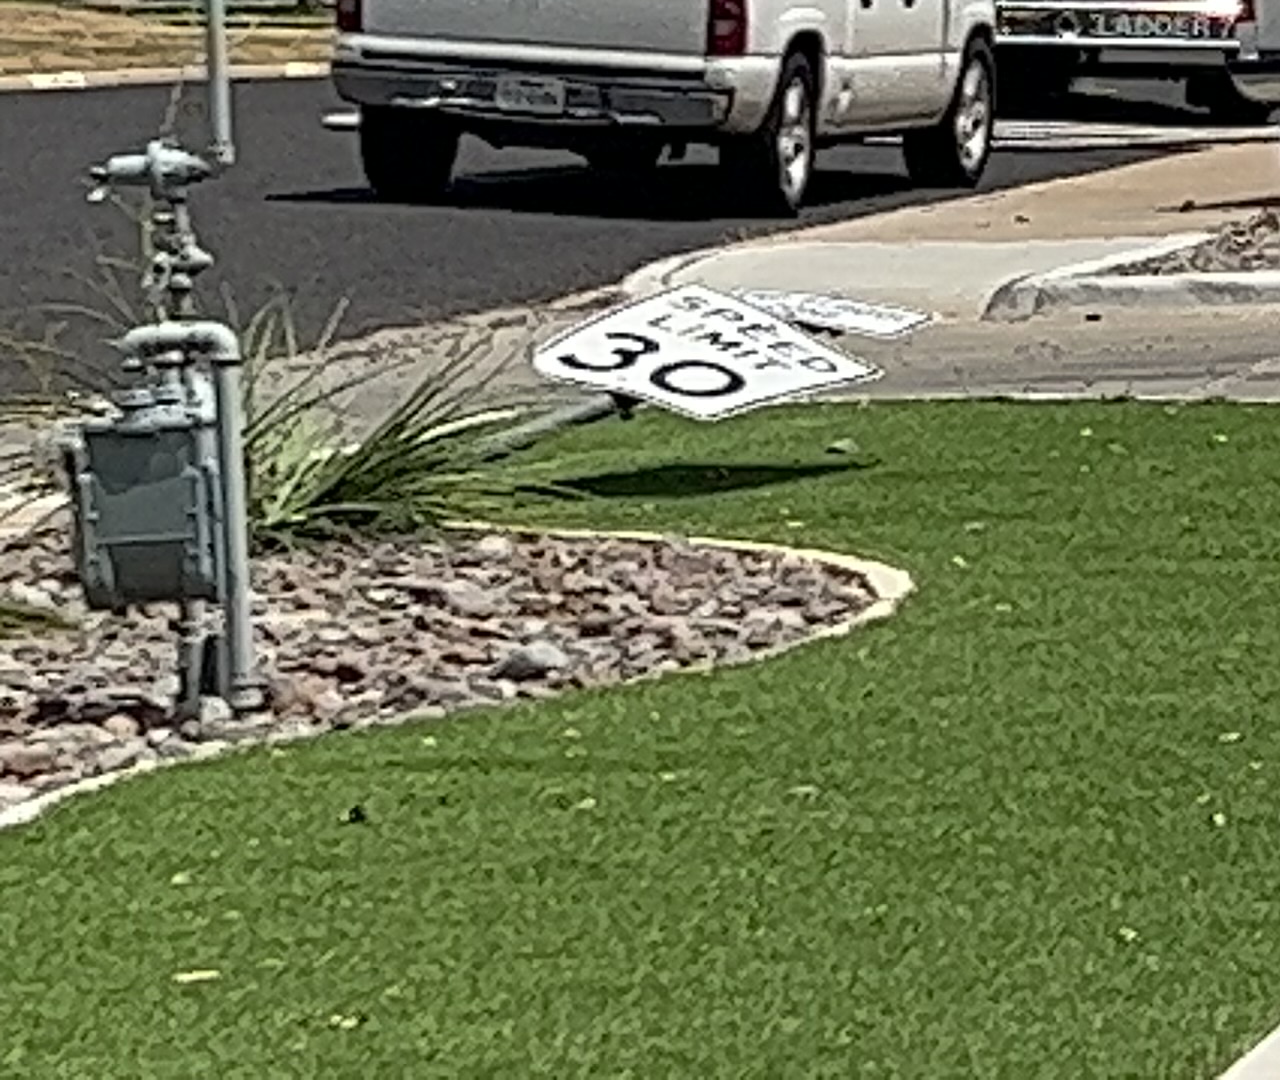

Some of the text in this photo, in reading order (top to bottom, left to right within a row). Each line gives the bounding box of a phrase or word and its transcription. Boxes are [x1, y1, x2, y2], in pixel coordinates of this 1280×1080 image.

[1088, 13, 1210, 37] LADDER
[557, 332, 746, 398] 30
[648, 314, 793, 370] LIMIT
[668, 296, 838, 373] SPEED
